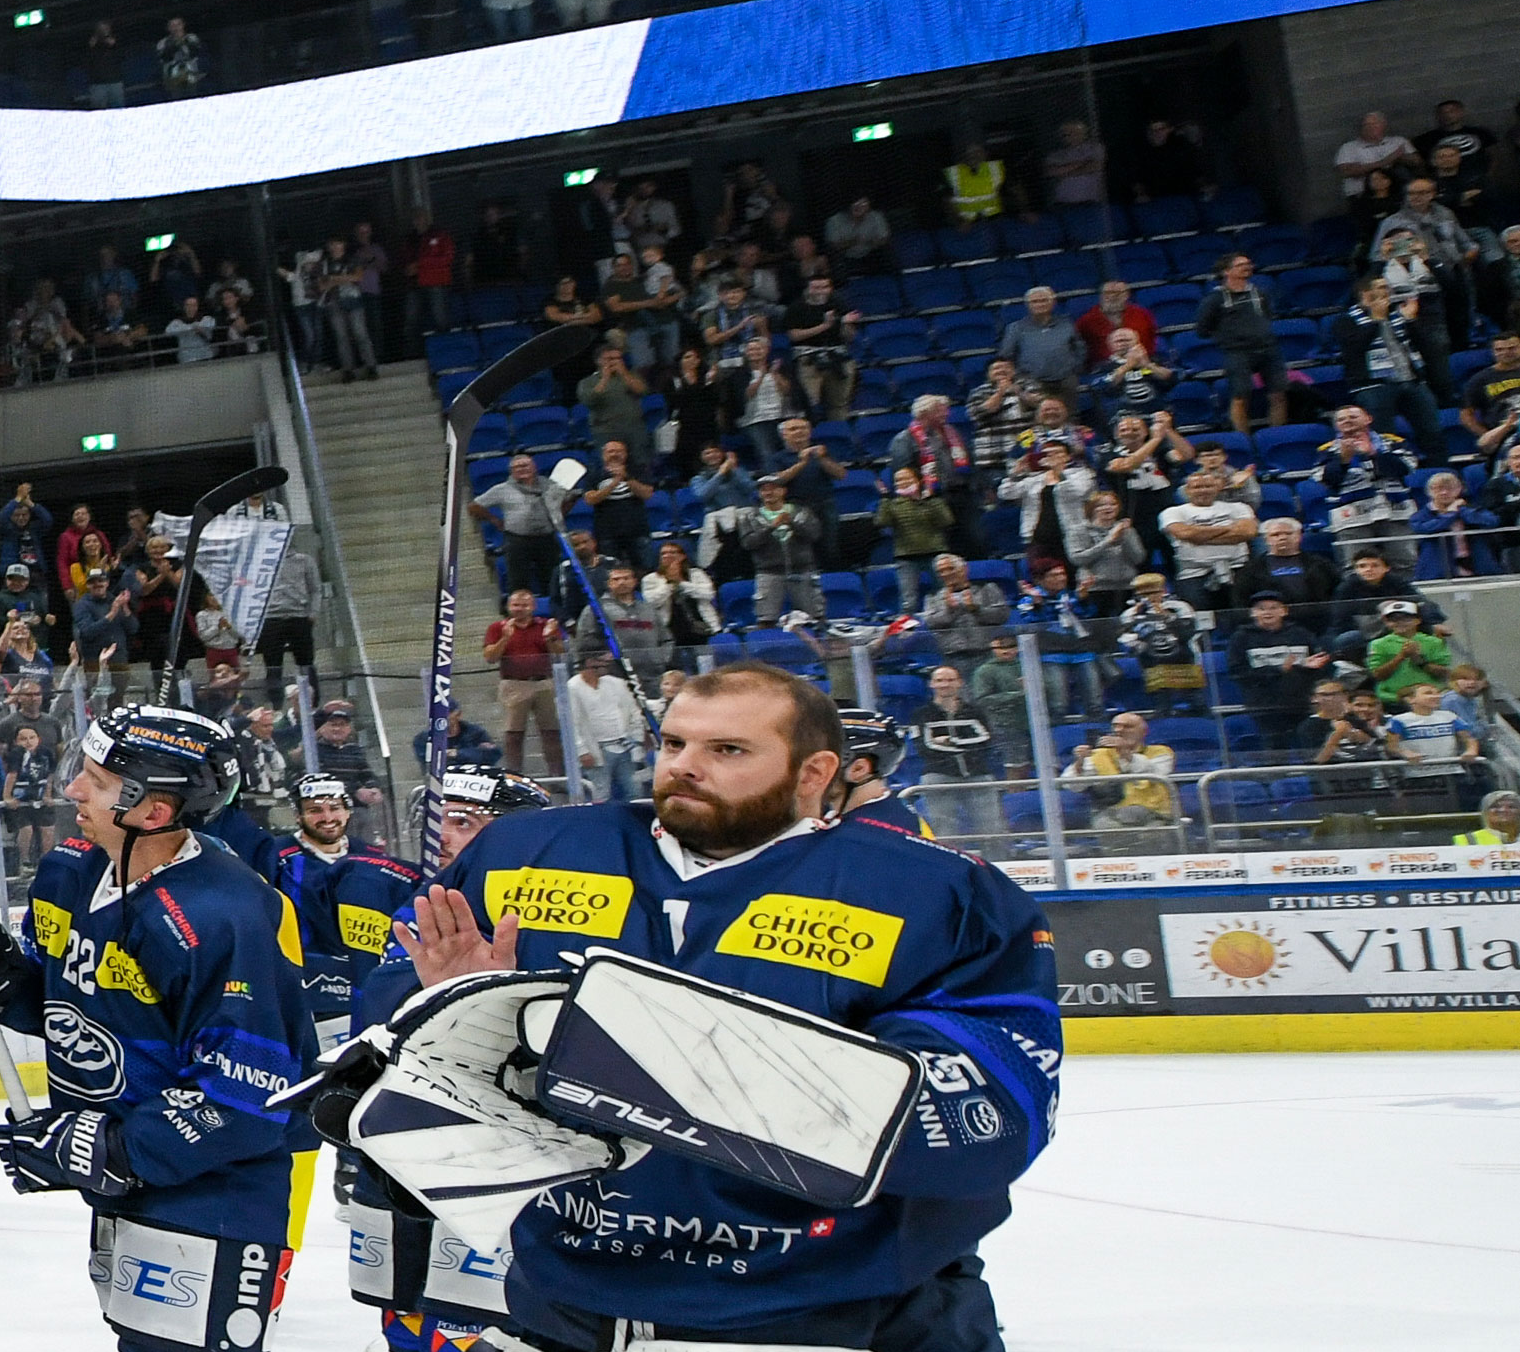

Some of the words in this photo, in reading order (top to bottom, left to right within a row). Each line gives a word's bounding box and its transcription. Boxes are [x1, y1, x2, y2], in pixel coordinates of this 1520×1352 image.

[223, 758, 240, 778] 22
[1184, 868, 1248, 881] FERRARI
[1291, 864, 1357, 878] FERRARI
[1389, 861, 1457, 875] FERRARI
[784, 903, 851, 925] CAFFÈ
[1268, 893, 1377, 910] FITNESS
[747, 911, 875, 953] CHICCO
[1303, 925, 1520, 974] Villa
[60, 928, 97, 996] 22
[753, 933, 860, 969] D'ORO
[162, 1107, 202, 1146] ANNI
[546, 1079, 708, 1149] TRUE
[535, 1189, 803, 1255] ANDERMATT
[350, 1228, 387, 1268] ES
[660, 1246, 750, 1277] ALPS
[114, 1255, 208, 1309] SES
